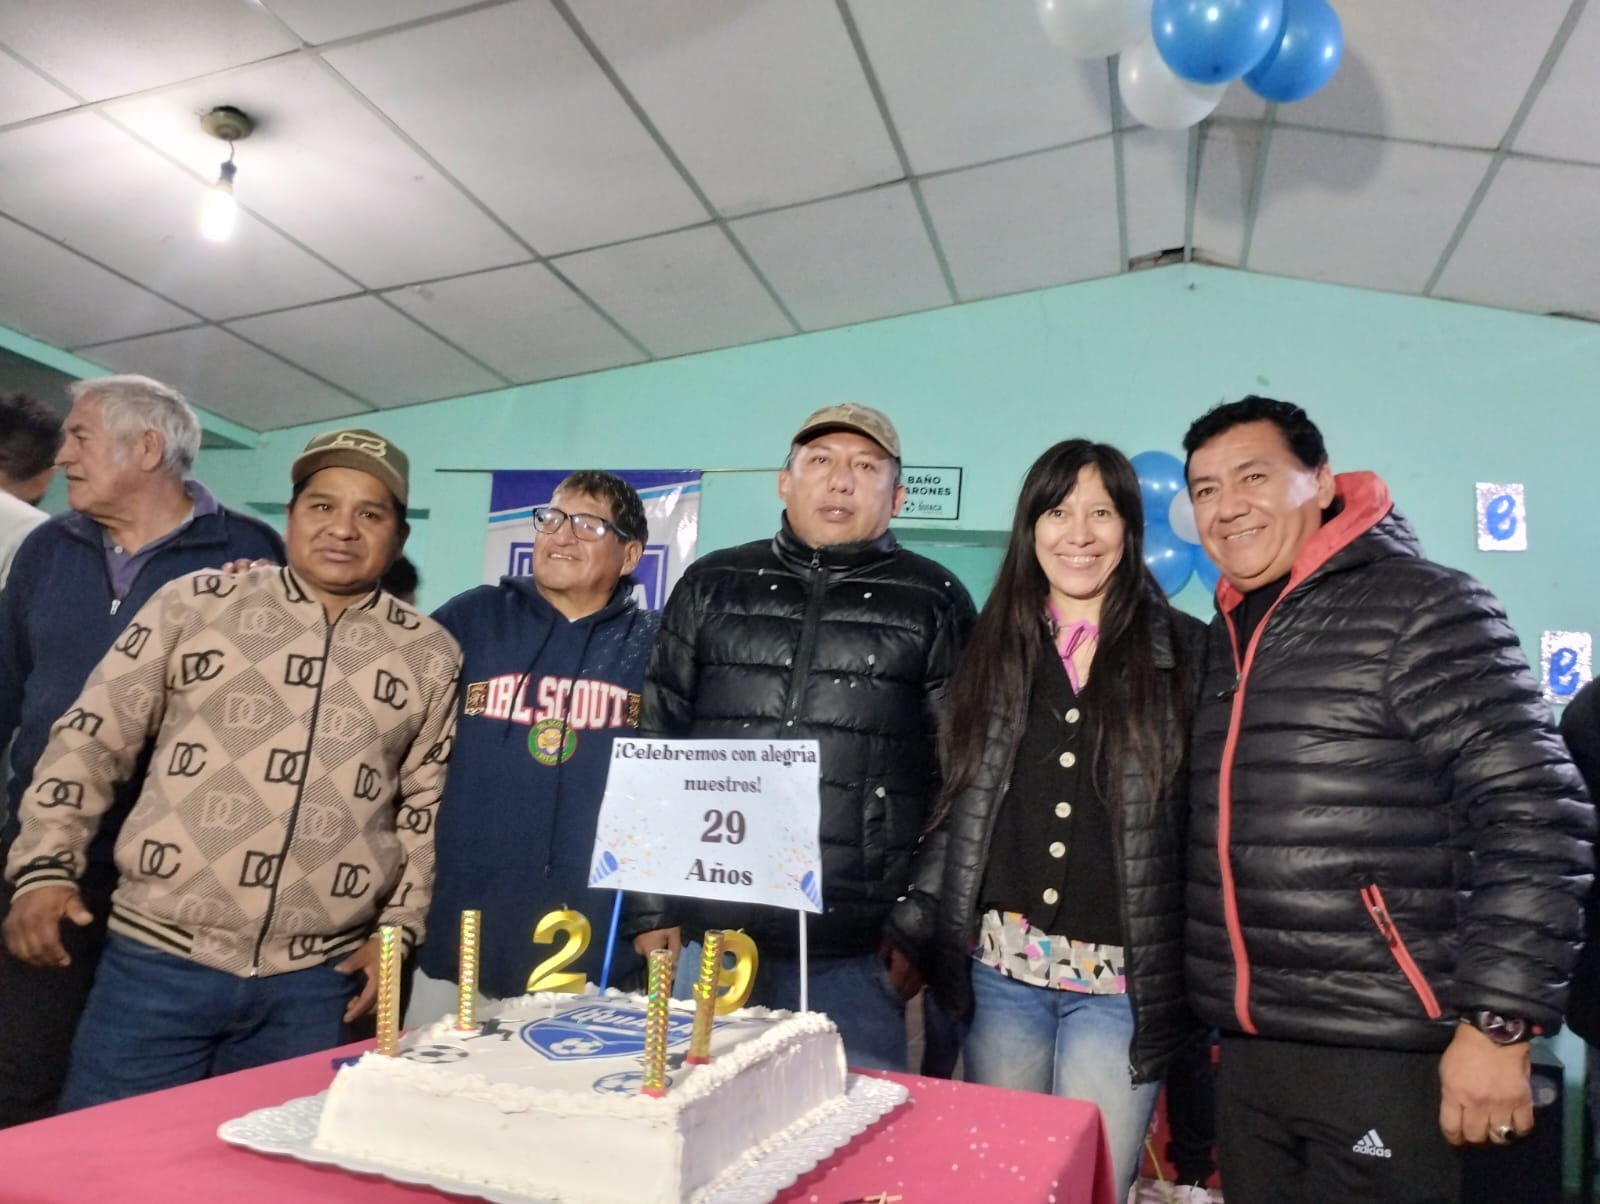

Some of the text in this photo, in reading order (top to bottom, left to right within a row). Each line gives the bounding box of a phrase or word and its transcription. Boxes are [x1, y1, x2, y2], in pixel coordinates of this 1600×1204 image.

[907, 474, 942, 485] BAÑO
[905, 487, 951, 496] ARONES
[614, 742, 817, 767] ¡Celebremos con alegría
[683, 776, 762, 793] nuestros!
[700, 809, 747, 845] 29
[684, 858, 753, 886] Años
[526, 908, 759, 1016] 2 9
[1352, 1144, 1392, 1159] adidas
